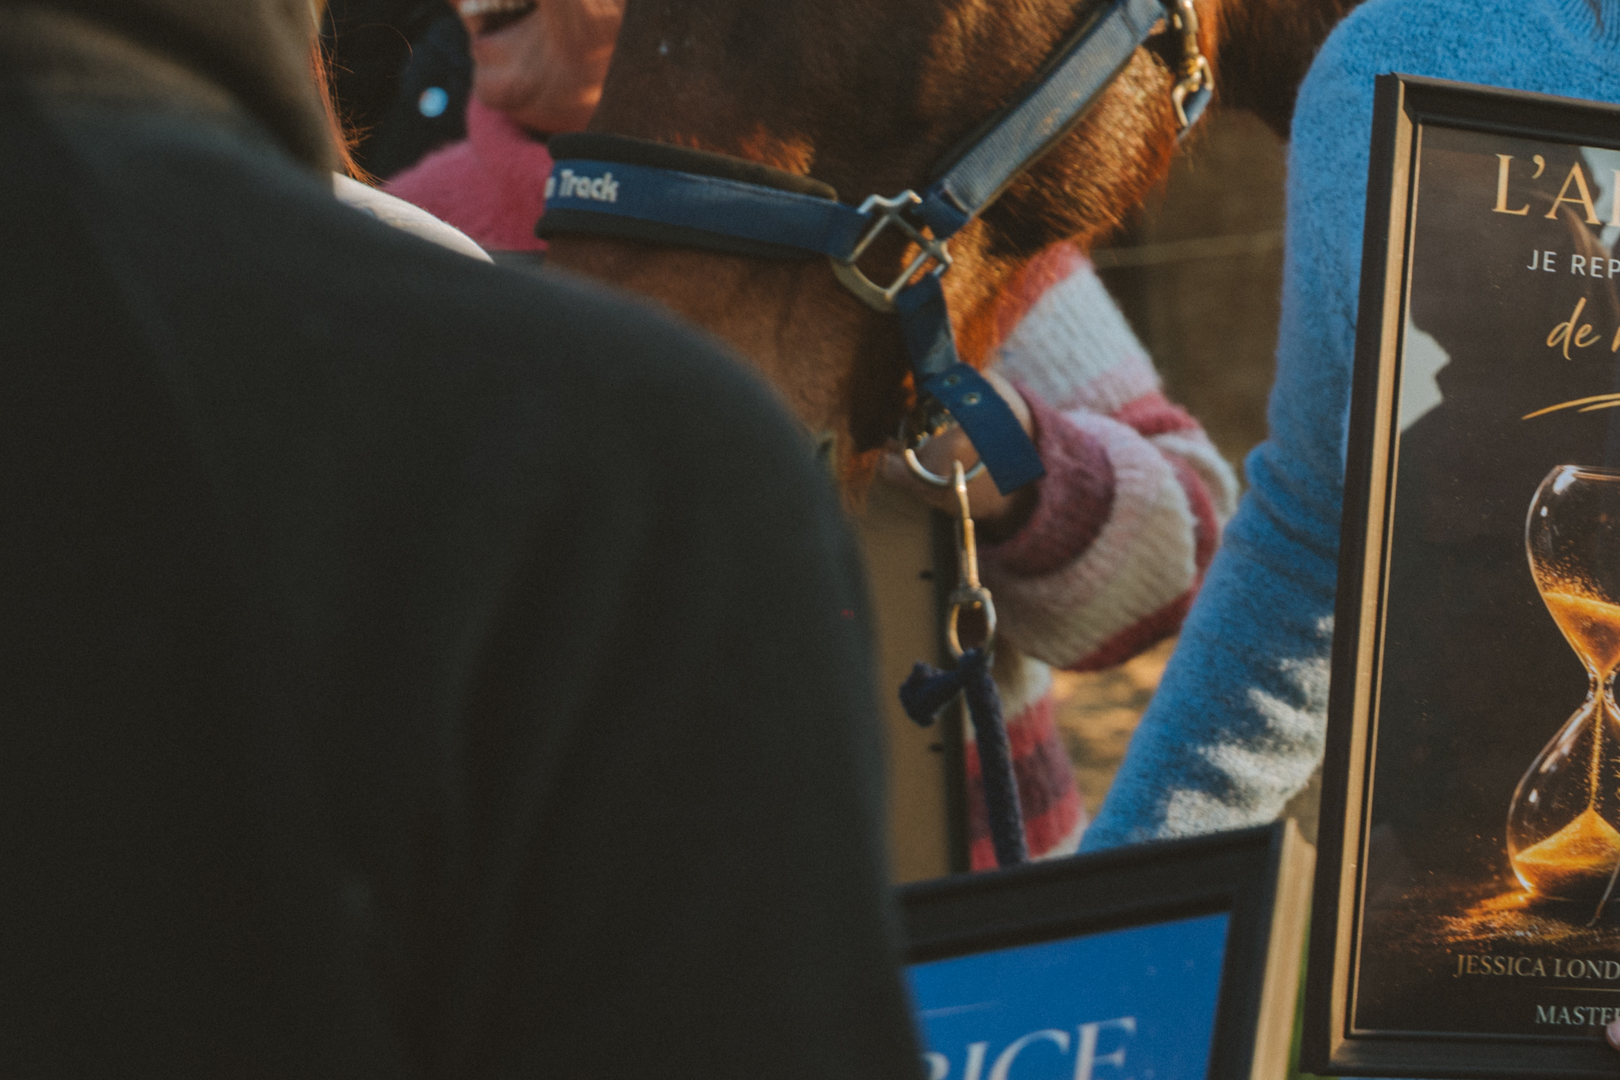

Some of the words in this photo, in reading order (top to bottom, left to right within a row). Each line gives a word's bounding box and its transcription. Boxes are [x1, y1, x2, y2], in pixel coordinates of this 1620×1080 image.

[558, 167, 621, 204] Track
[1526, 248, 1558, 273] JE
[1545, 296, 1601, 362] de
[1452, 953, 1547, 979] JESSICA
